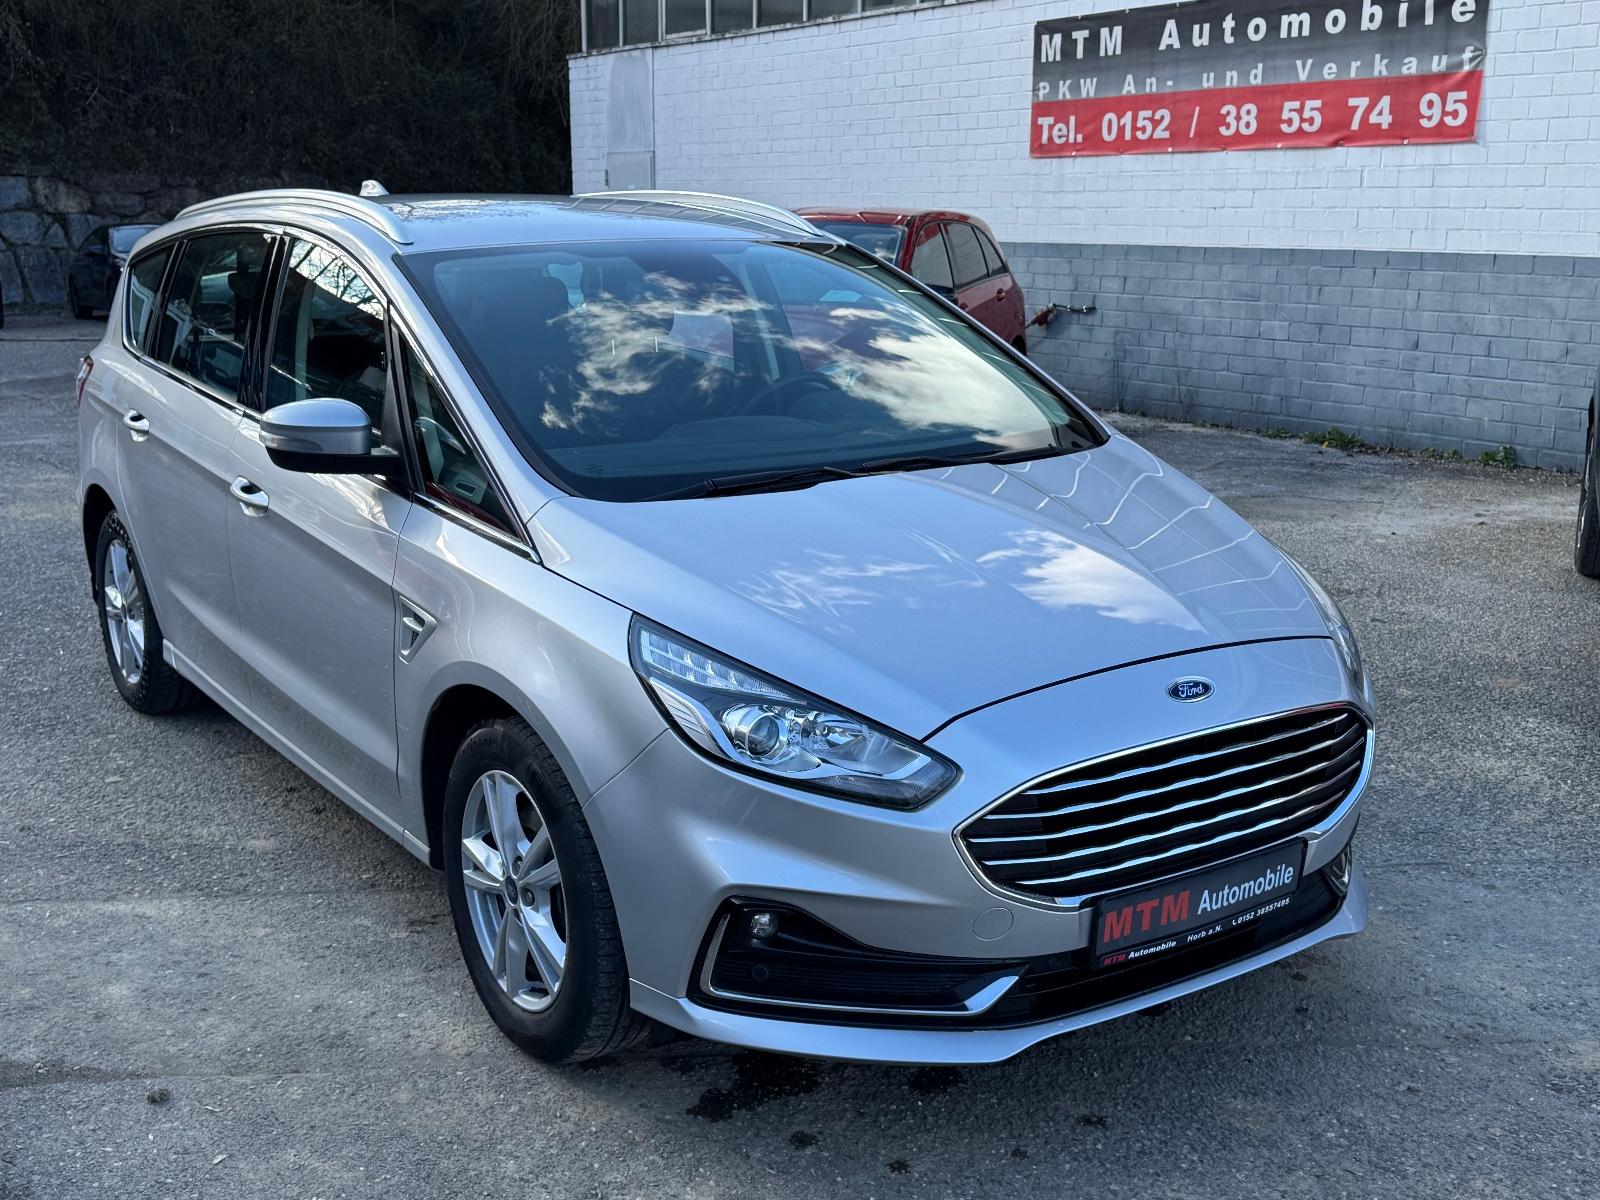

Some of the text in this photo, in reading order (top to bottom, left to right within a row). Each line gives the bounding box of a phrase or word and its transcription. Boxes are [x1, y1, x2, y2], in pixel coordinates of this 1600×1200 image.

[1040, 0, 1476, 63] MTM Automobile
[1037, 46, 1475, 101] PKW An- und Verkauf
[1037, 91, 1468, 145] Tel. 0152 / 38 55 74 95
[1178, 682, 1205, 698] Ford
[1103, 863, 1294, 943] MTM Automobile
[1104, 954, 1127, 966] MTM
[1128, 940, 1177, 959] Automobile
[1187, 930, 1206, 943] Horb
